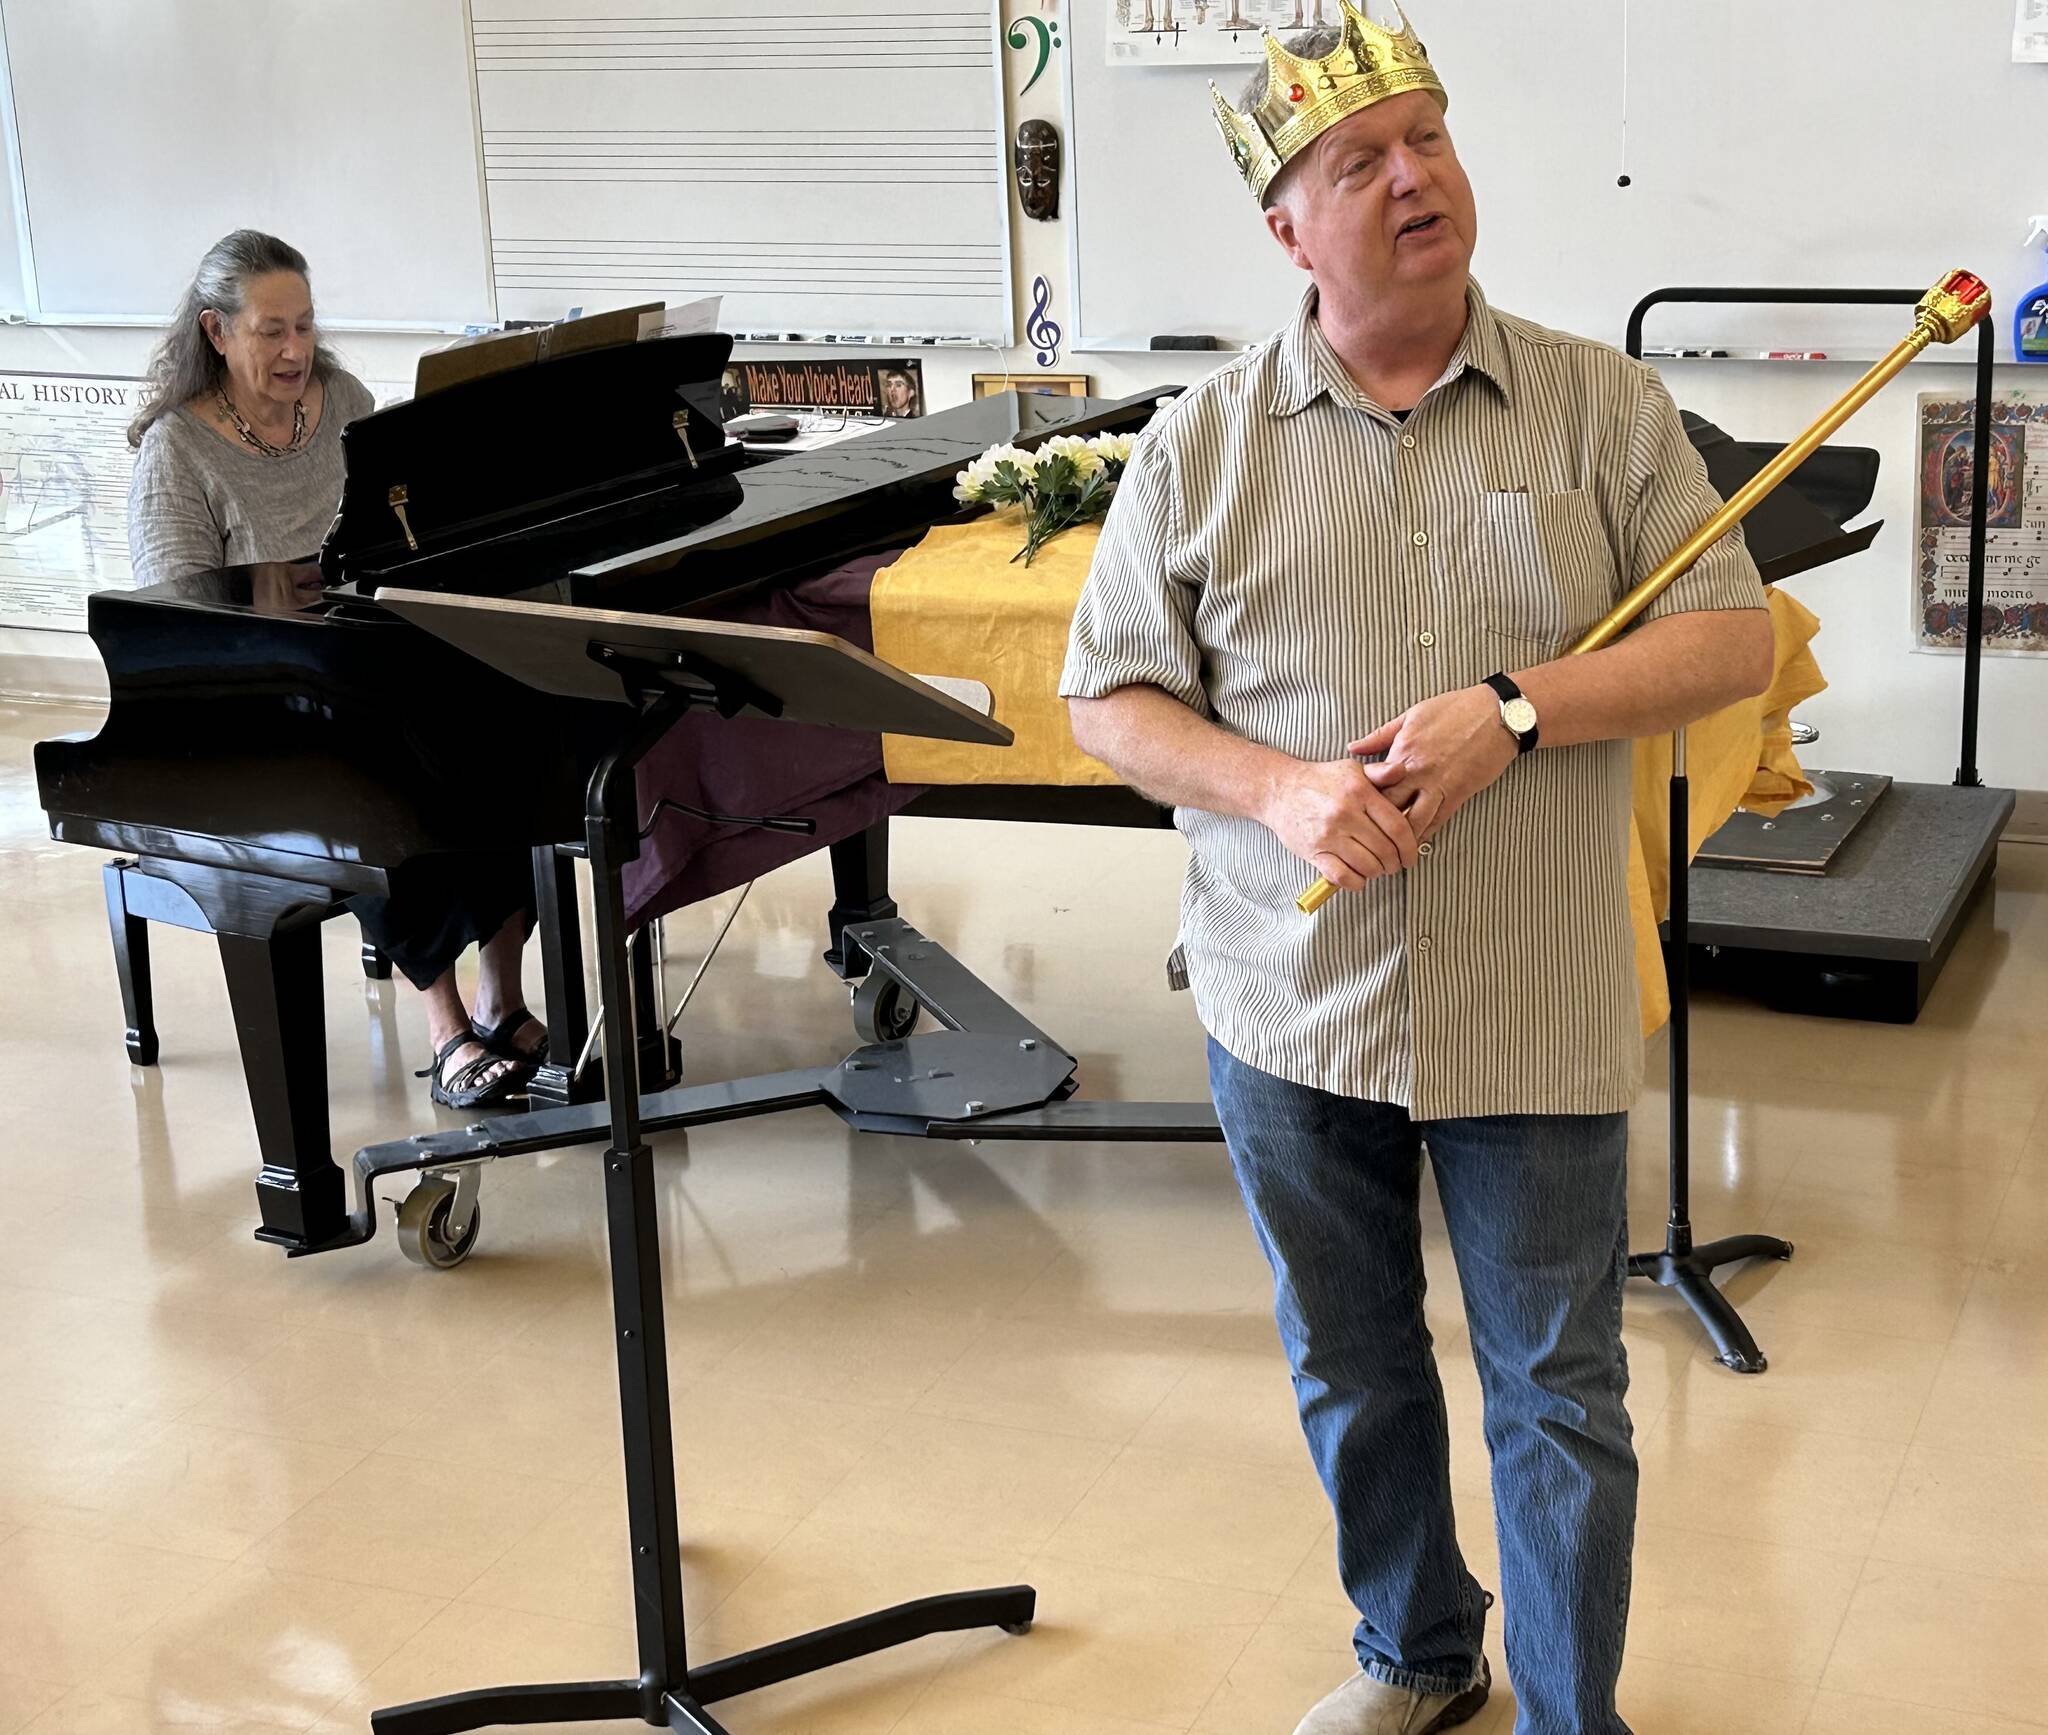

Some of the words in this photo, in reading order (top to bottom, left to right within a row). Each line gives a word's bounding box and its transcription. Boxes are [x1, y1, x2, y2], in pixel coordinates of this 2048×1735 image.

[32, 384, 128, 406] HISTORY
[745, 364, 780, 404] Make
[777, 364, 806, 404] Your
[803, 364, 838, 405] Voice
